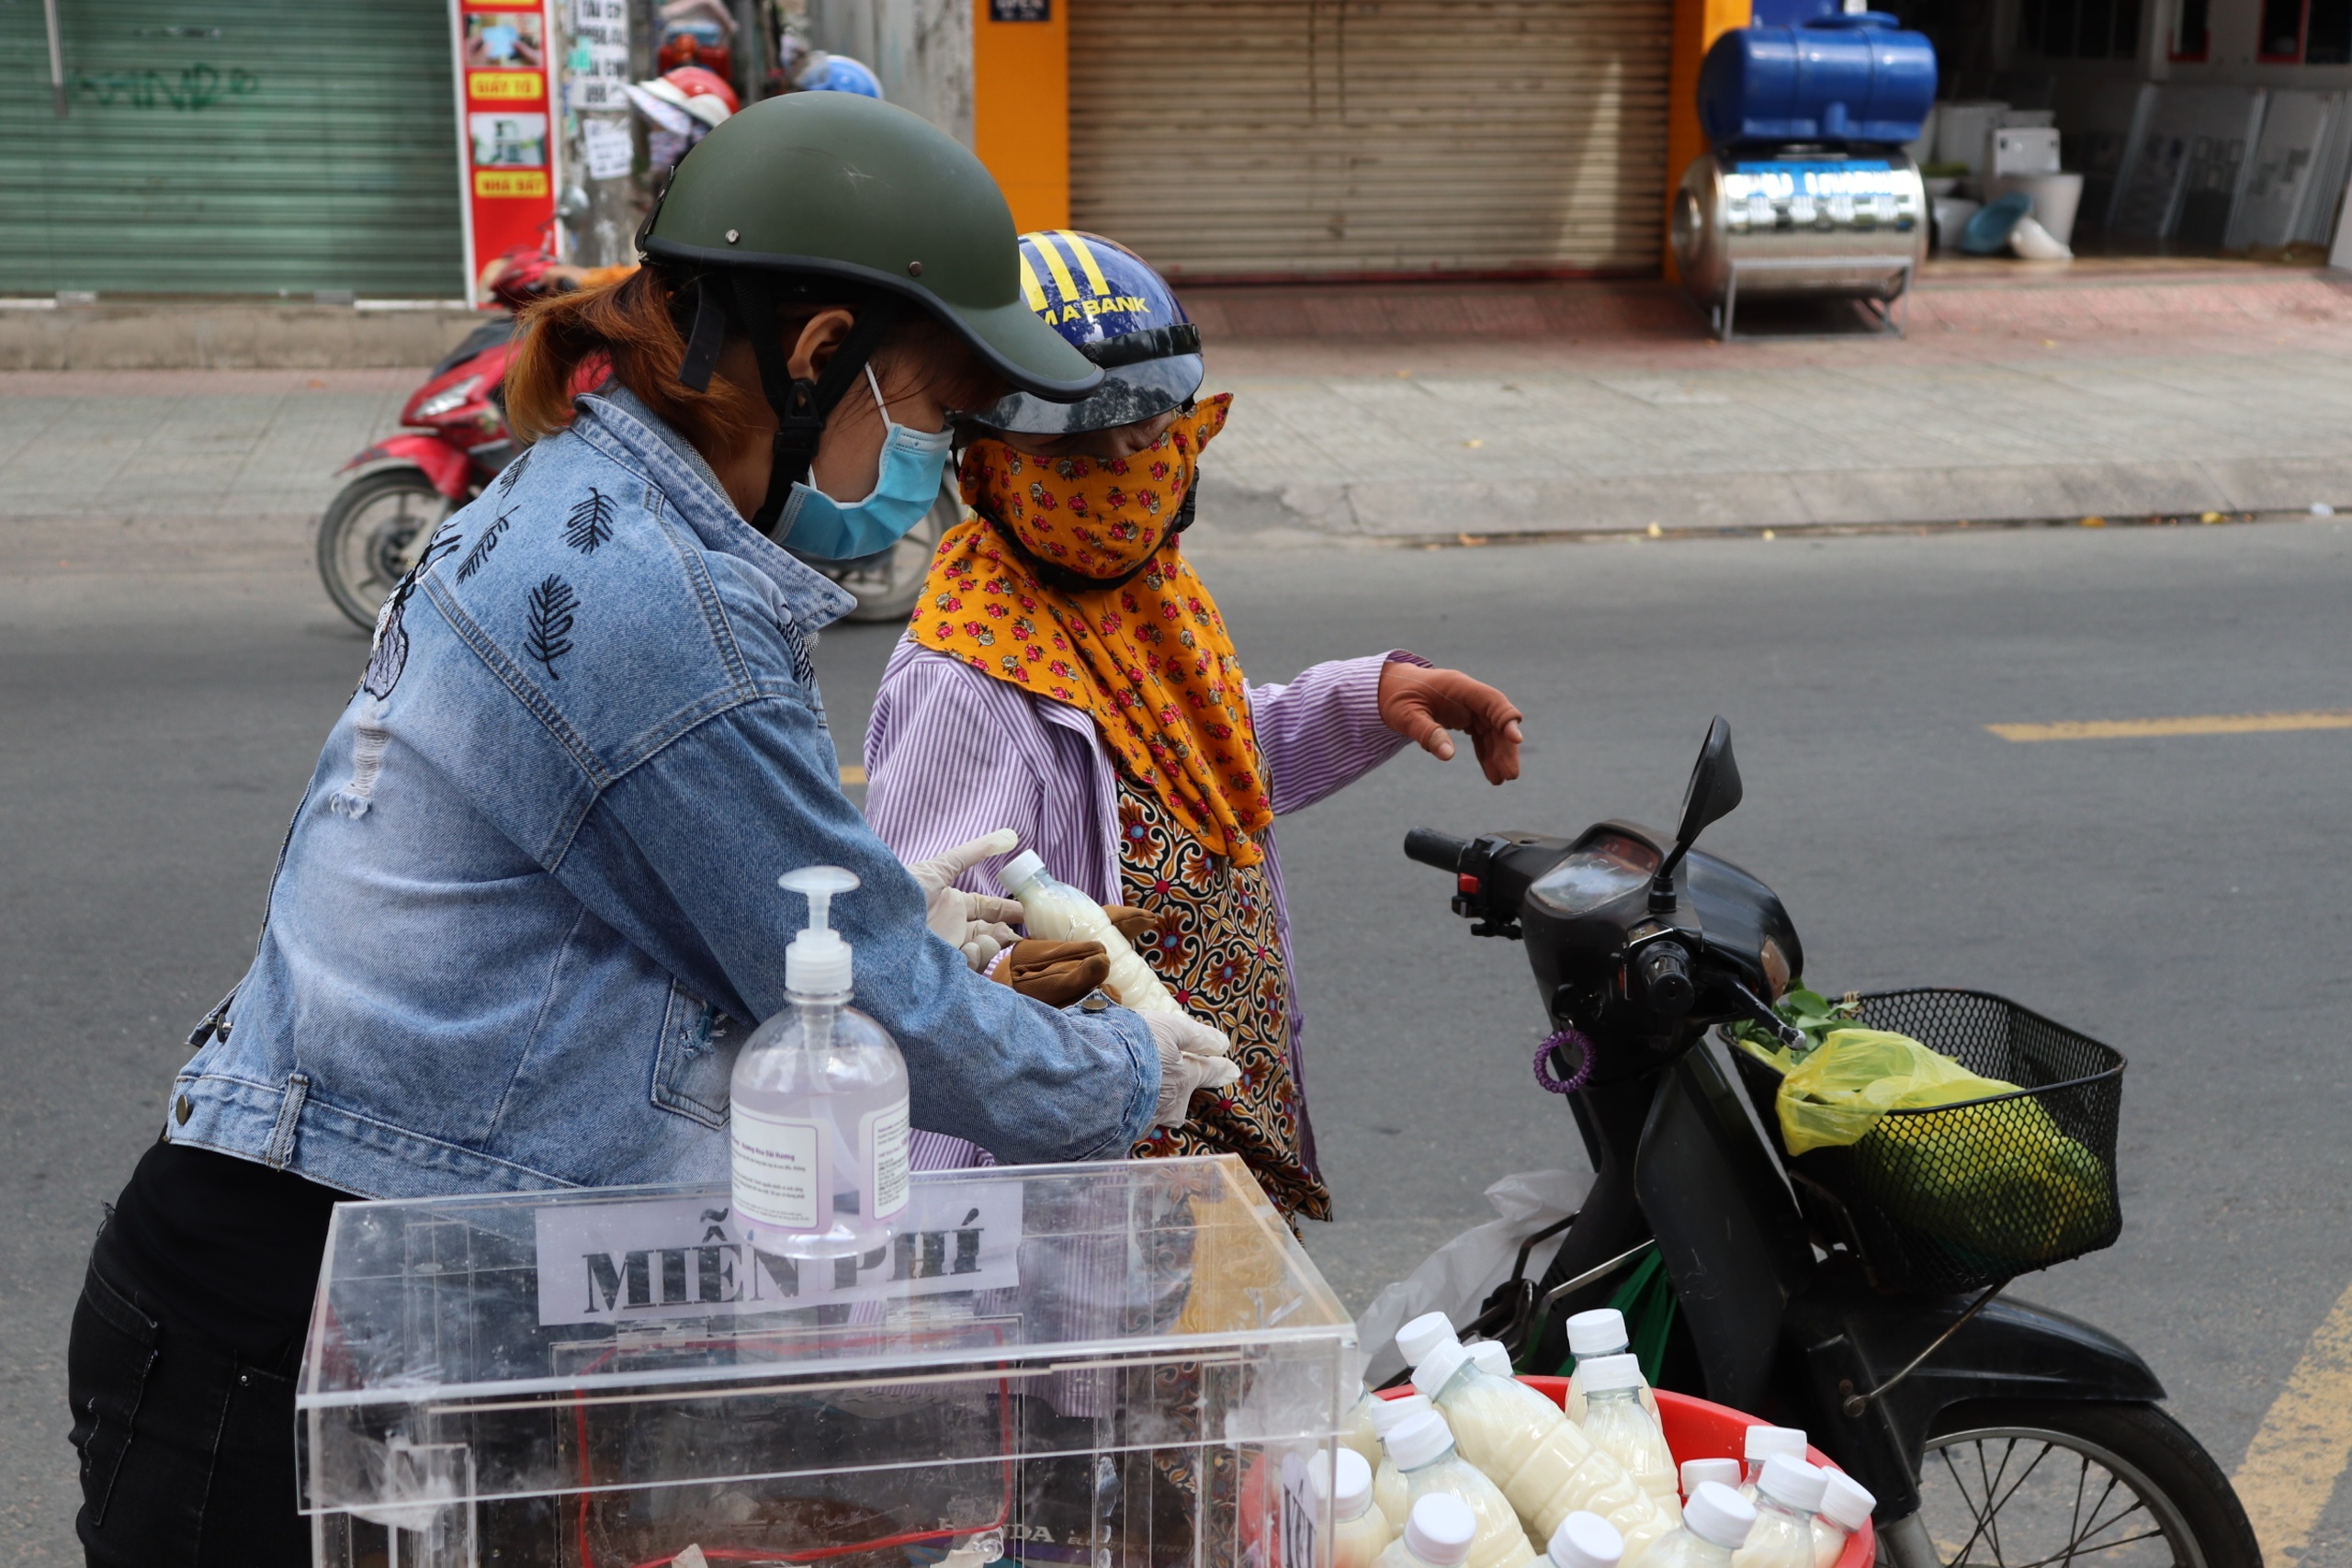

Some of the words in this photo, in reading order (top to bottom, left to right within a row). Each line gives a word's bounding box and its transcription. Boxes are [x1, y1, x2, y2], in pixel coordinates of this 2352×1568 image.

[1081, 296, 1151, 316] BANK
[582, 1207, 800, 1314] MIỄN
[831, 1207, 985, 1291] PHÍ
